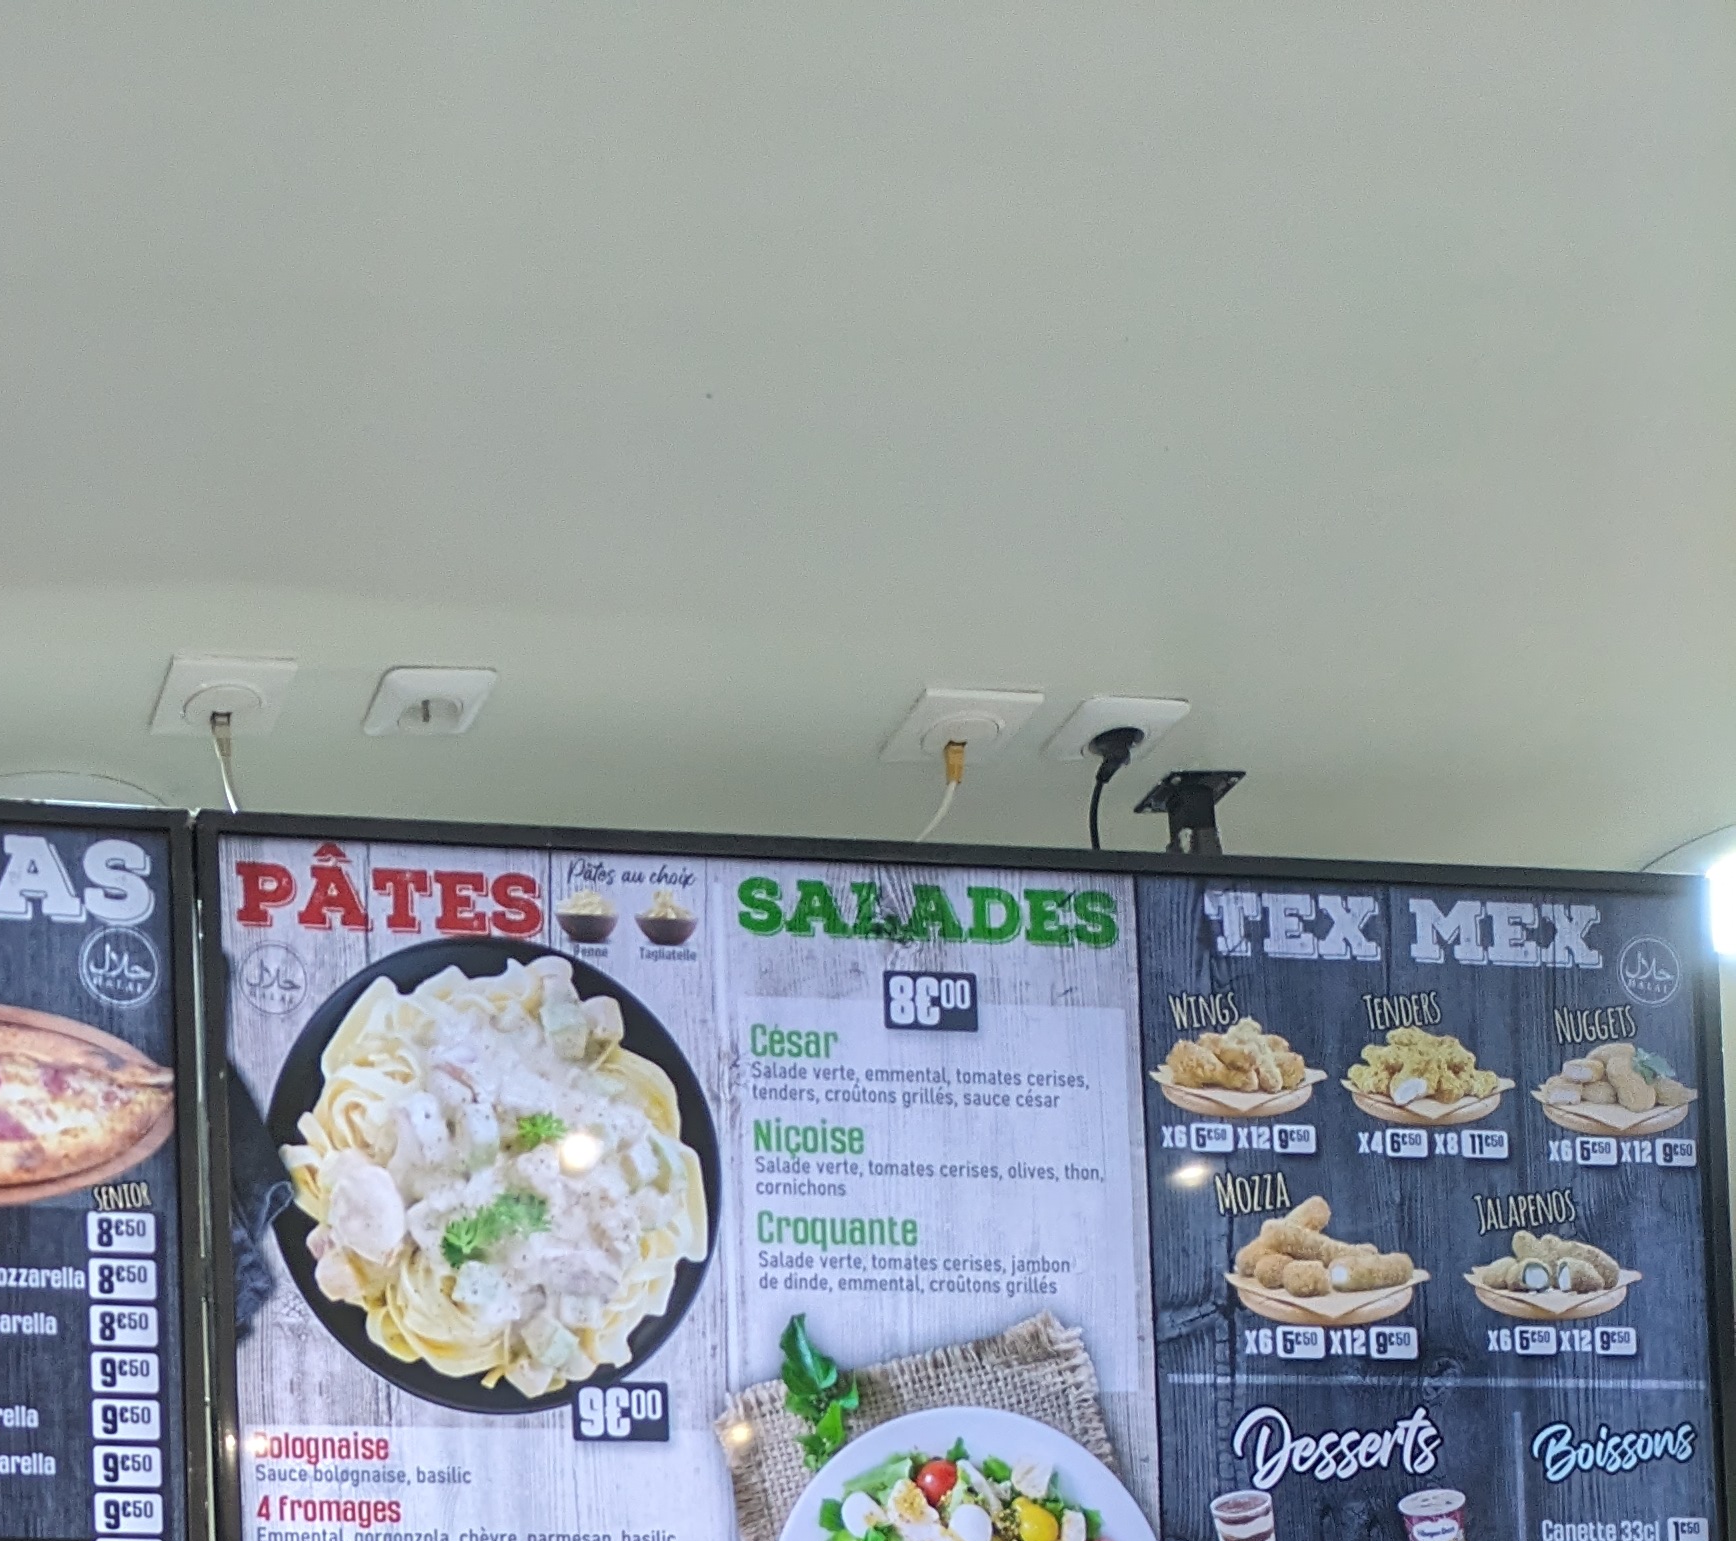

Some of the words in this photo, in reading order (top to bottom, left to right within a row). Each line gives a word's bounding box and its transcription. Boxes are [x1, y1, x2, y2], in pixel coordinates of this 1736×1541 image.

[568, 857, 615, 886] Pâtes
[622, 868, 645, 883] au
[649, 862, 697, 888] choix
[235, 842, 544, 937] PÂTES
[737, 876, 1119, 949] SALADES
[1203, 890, 1382, 963] TEX
[1409, 897, 1603, 969] MEX
[889, 976, 971, 1025] 8€00
[750, 1024, 838, 1058] César
[753, 1118, 865, 1157] Niçoise
[1358, 1130, 1383, 1153] X4
[1434, 1131, 1459, 1154] X8
[755, 1157, 812, 1174] Salade
[817, 1159, 863, 1177] verte,
[869, 1159, 934, 1178] tomates
[939, 1160, 1003, 1180] cerises,
[1008, 1162, 1059, 1182] olives,
[1064, 1163, 1104, 1182] thon,
[93, 1183, 150, 1211] SENIOR
[756, 1178, 846, 1196] cornichons
[97, 1217, 147, 1247] 8€50
[757, 1210, 918, 1251] Croquante
[98, 1264, 148, 1294] 8€50
[99, 1312, 149, 1341] 8€50
[579, 1389, 663, 1438] 9€00
[1233, 1405, 1443, 1489] Desserts
[1532, 1422, 1697, 1482] Boissons
[104, 1498, 154, 1529] 9€50
[257, 1496, 271, 1519] 4
[279, 1496, 401, 1528] fromages
